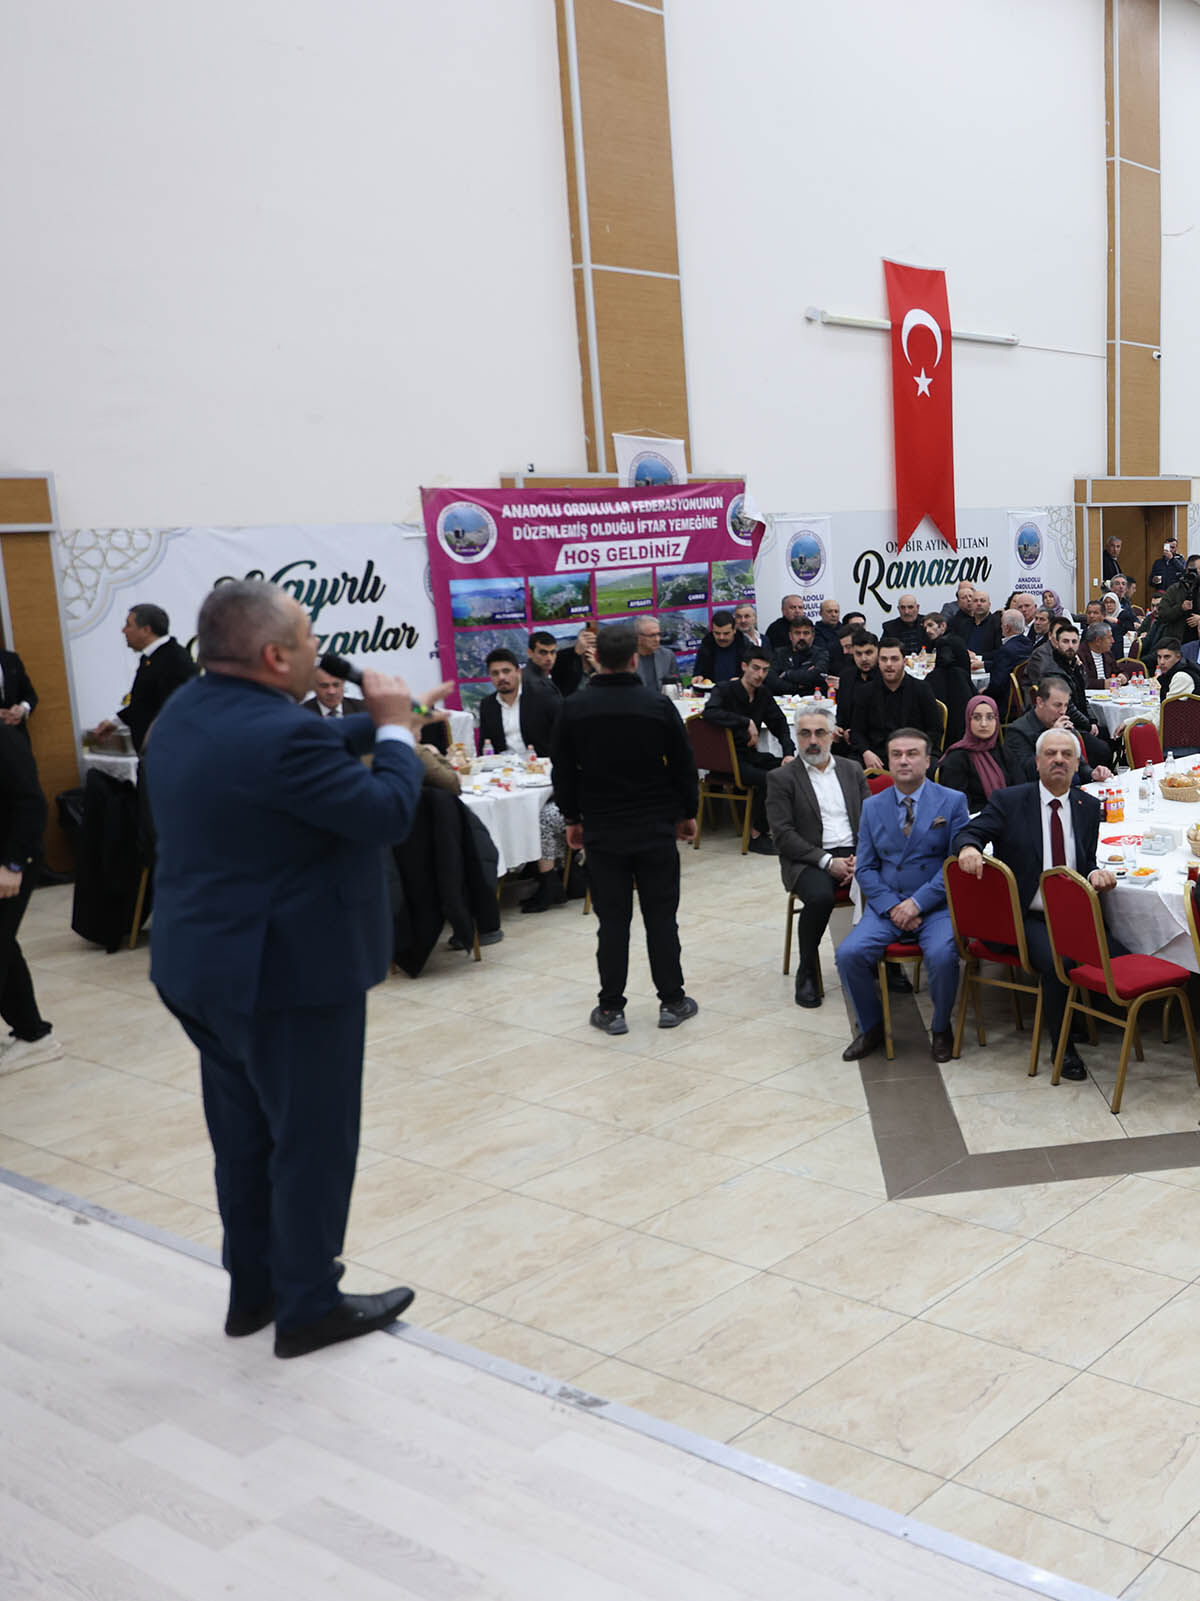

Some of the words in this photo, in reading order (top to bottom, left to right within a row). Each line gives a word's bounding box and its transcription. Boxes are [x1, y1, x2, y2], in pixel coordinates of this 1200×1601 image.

[502, 502, 562, 519] ANADOLU
[563, 499, 630, 517] ORDULULAR
[631, 496, 723, 513] FEDERASYONUNUN
[512, 521, 588, 540] DÜZENLEMİŞ
[590, 518, 635, 536] OLDUĞU
[636, 516, 667, 533] İFTAR
[668, 514, 718, 531] YEMEĞİNE
[564, 548, 601, 566] HOŞ
[606, 542, 681, 562] GELDİNİZ
[905, 537, 923, 552] BİR
[925, 539, 948, 551] AYIN
[954, 536, 989, 550] ULTANI
[852, 549, 992, 613] Ramazan
